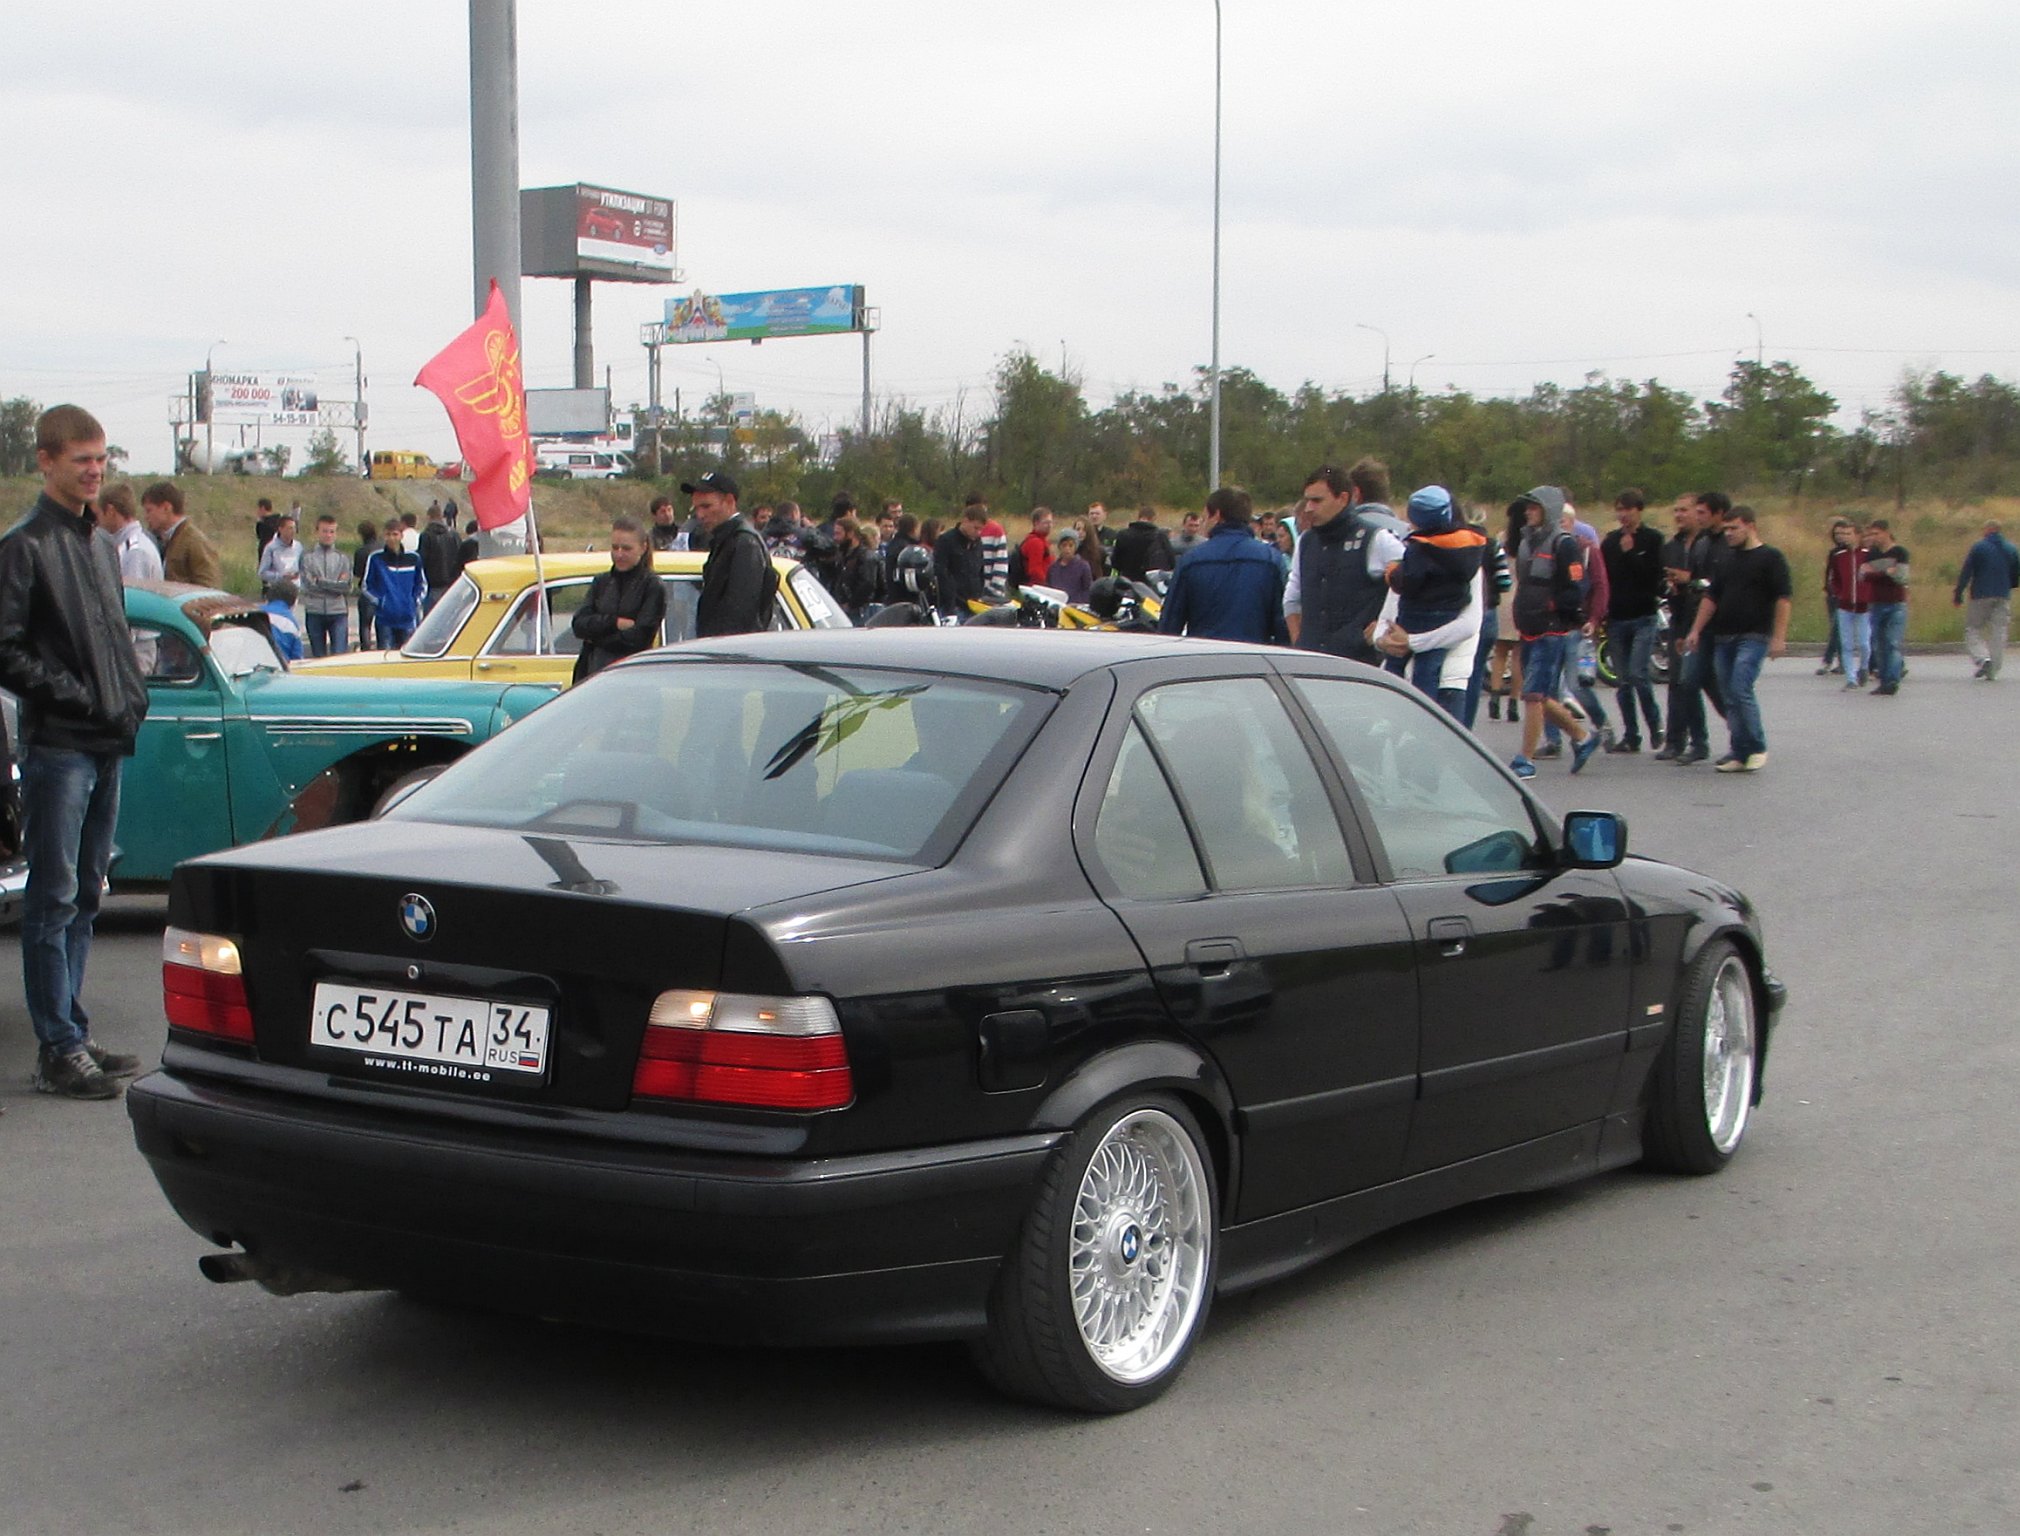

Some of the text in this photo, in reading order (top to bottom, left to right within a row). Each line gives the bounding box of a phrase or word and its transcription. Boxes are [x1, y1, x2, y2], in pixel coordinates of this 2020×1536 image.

[231, 387, 271, 400] 200 000
[327, 995, 476, 1057] С545ТА
[492, 1007, 532, 1049] 34
[364, 1056, 491, 1081] www.tt-mobile.ee
[488, 1048, 518, 1064] RUS
